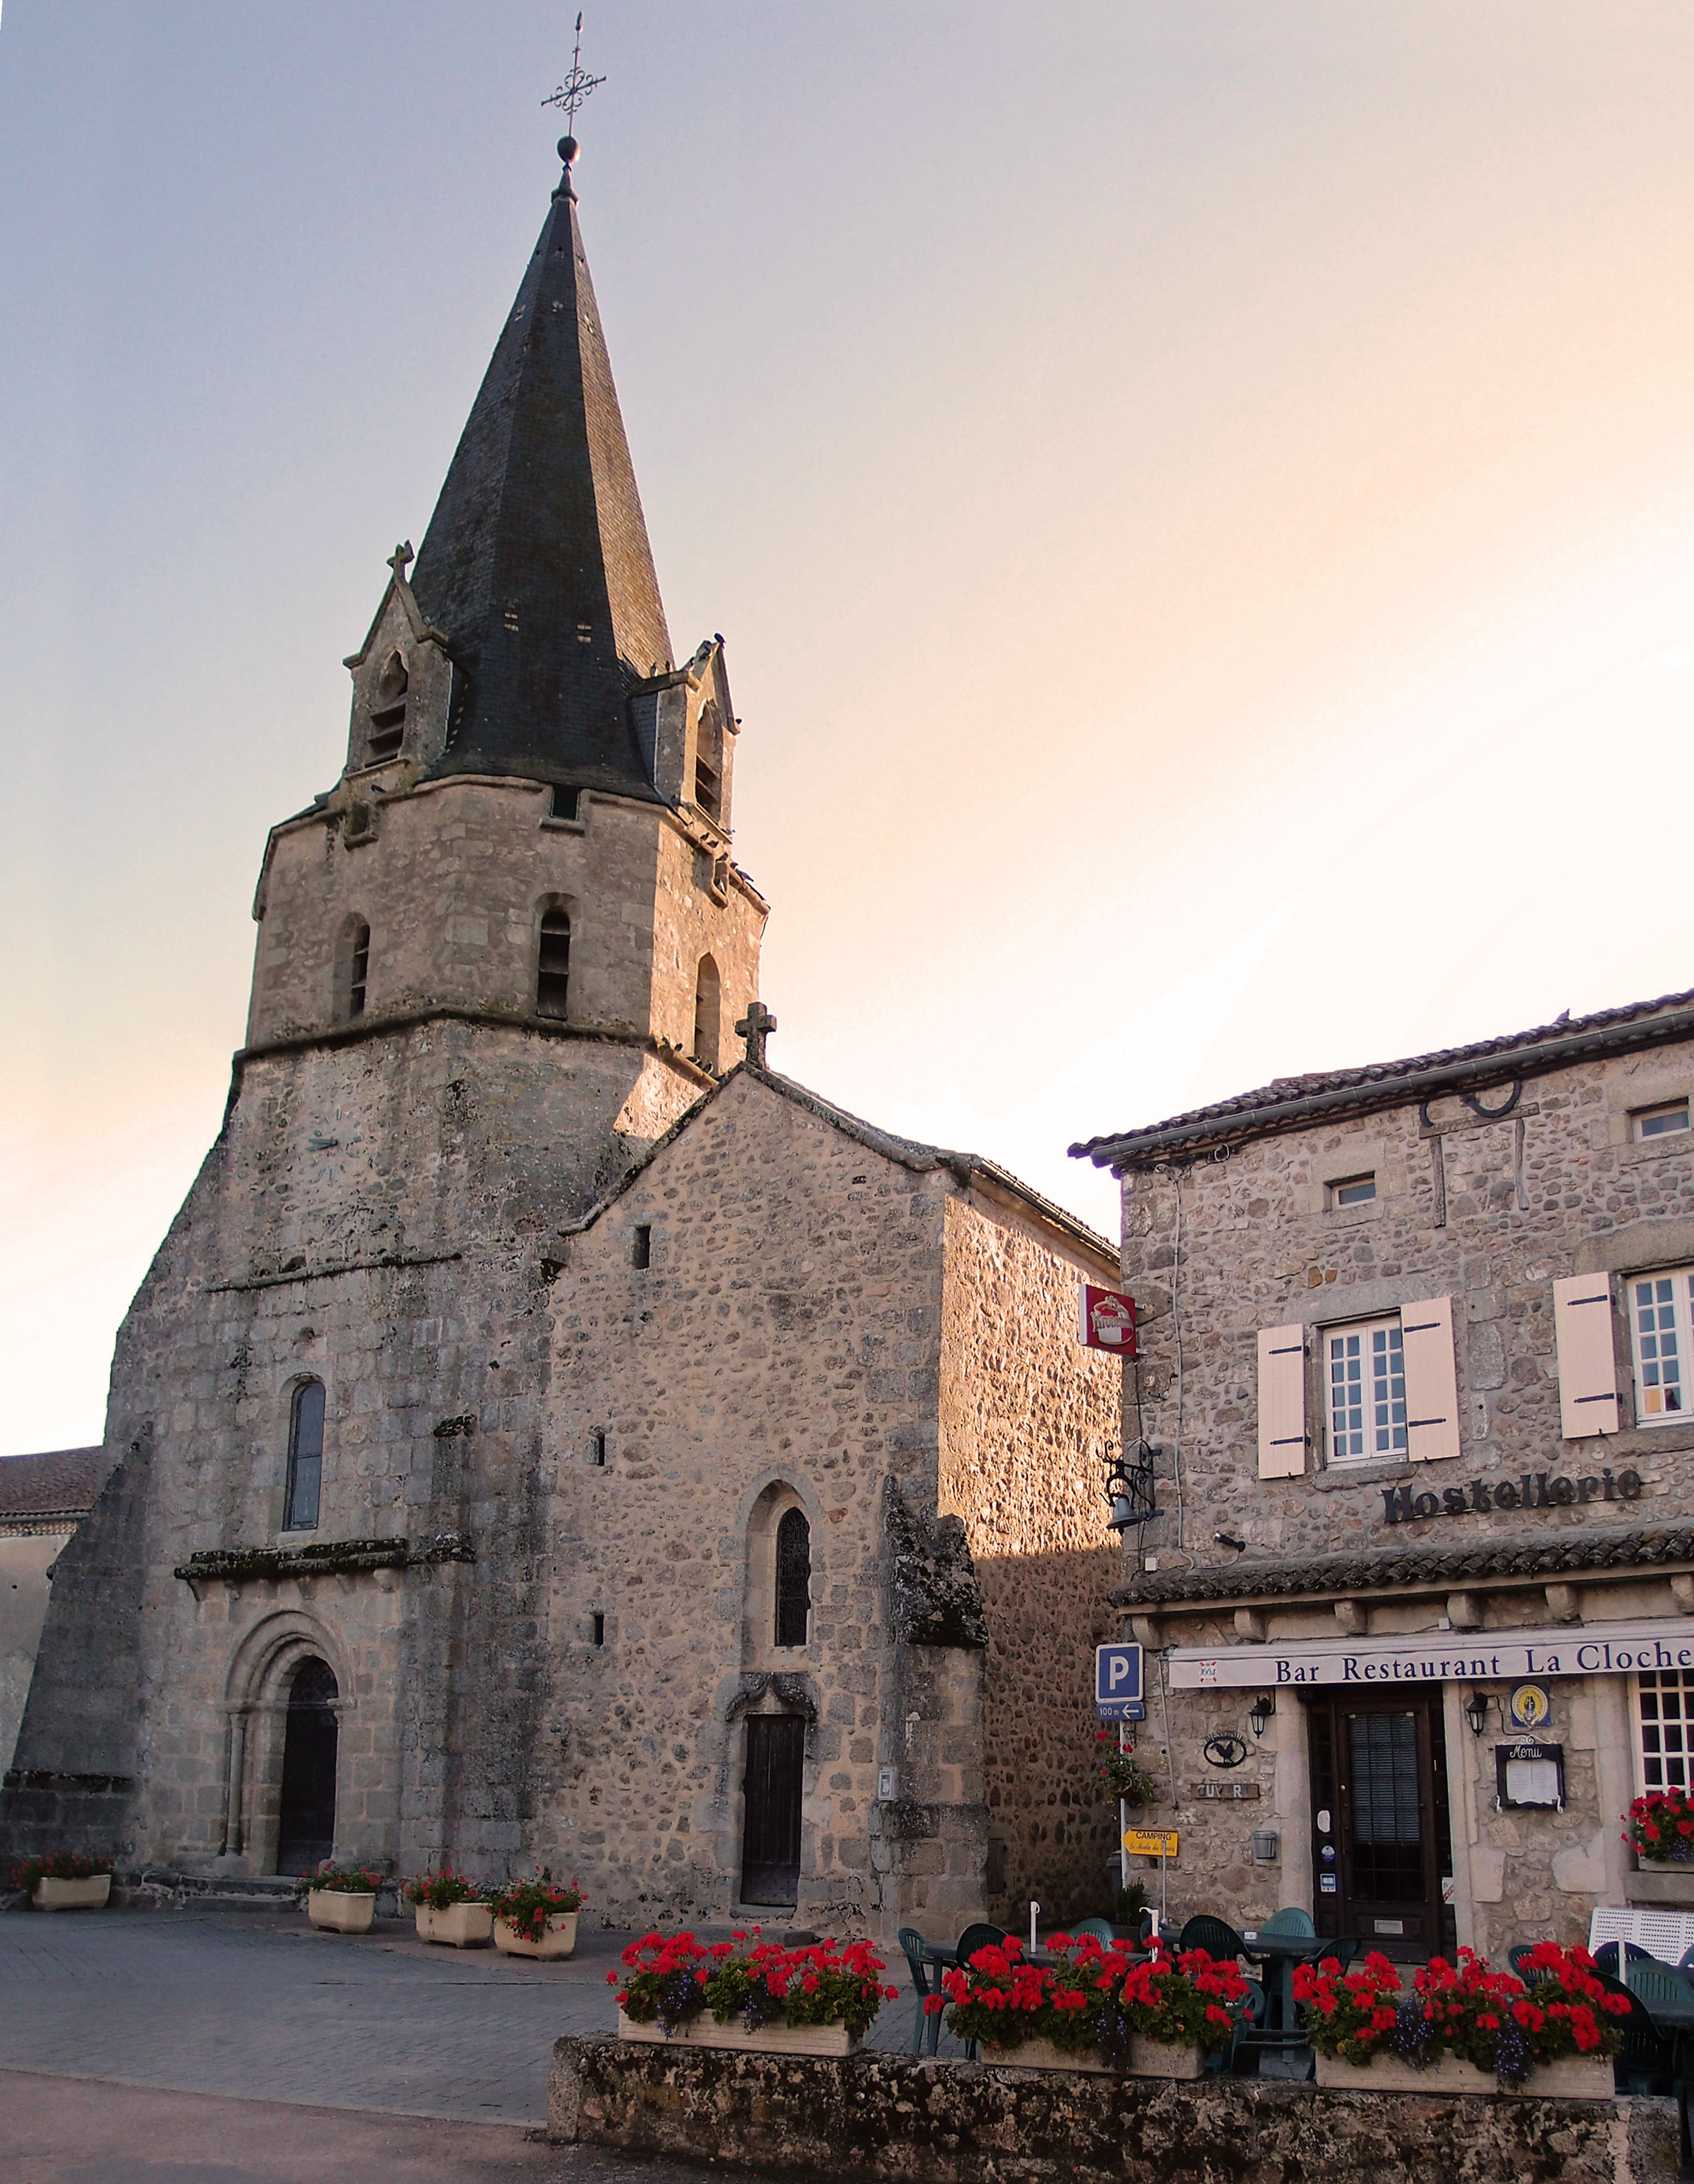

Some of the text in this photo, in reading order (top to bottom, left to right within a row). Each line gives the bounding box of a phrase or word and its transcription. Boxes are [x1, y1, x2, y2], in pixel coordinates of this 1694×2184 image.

[1381, 1468, 1643, 1523] Hostellerie
[1109, 1655, 1129, 1690] P
[1275, 1641, 1692, 1683] Bar Restaurant La Cloche
[1204, 1730, 1246, 1743] BIENVENUE
[1509, 1745, 1542, 1759] Menu
[1136, 1832, 1172, 1841] CAMPING
